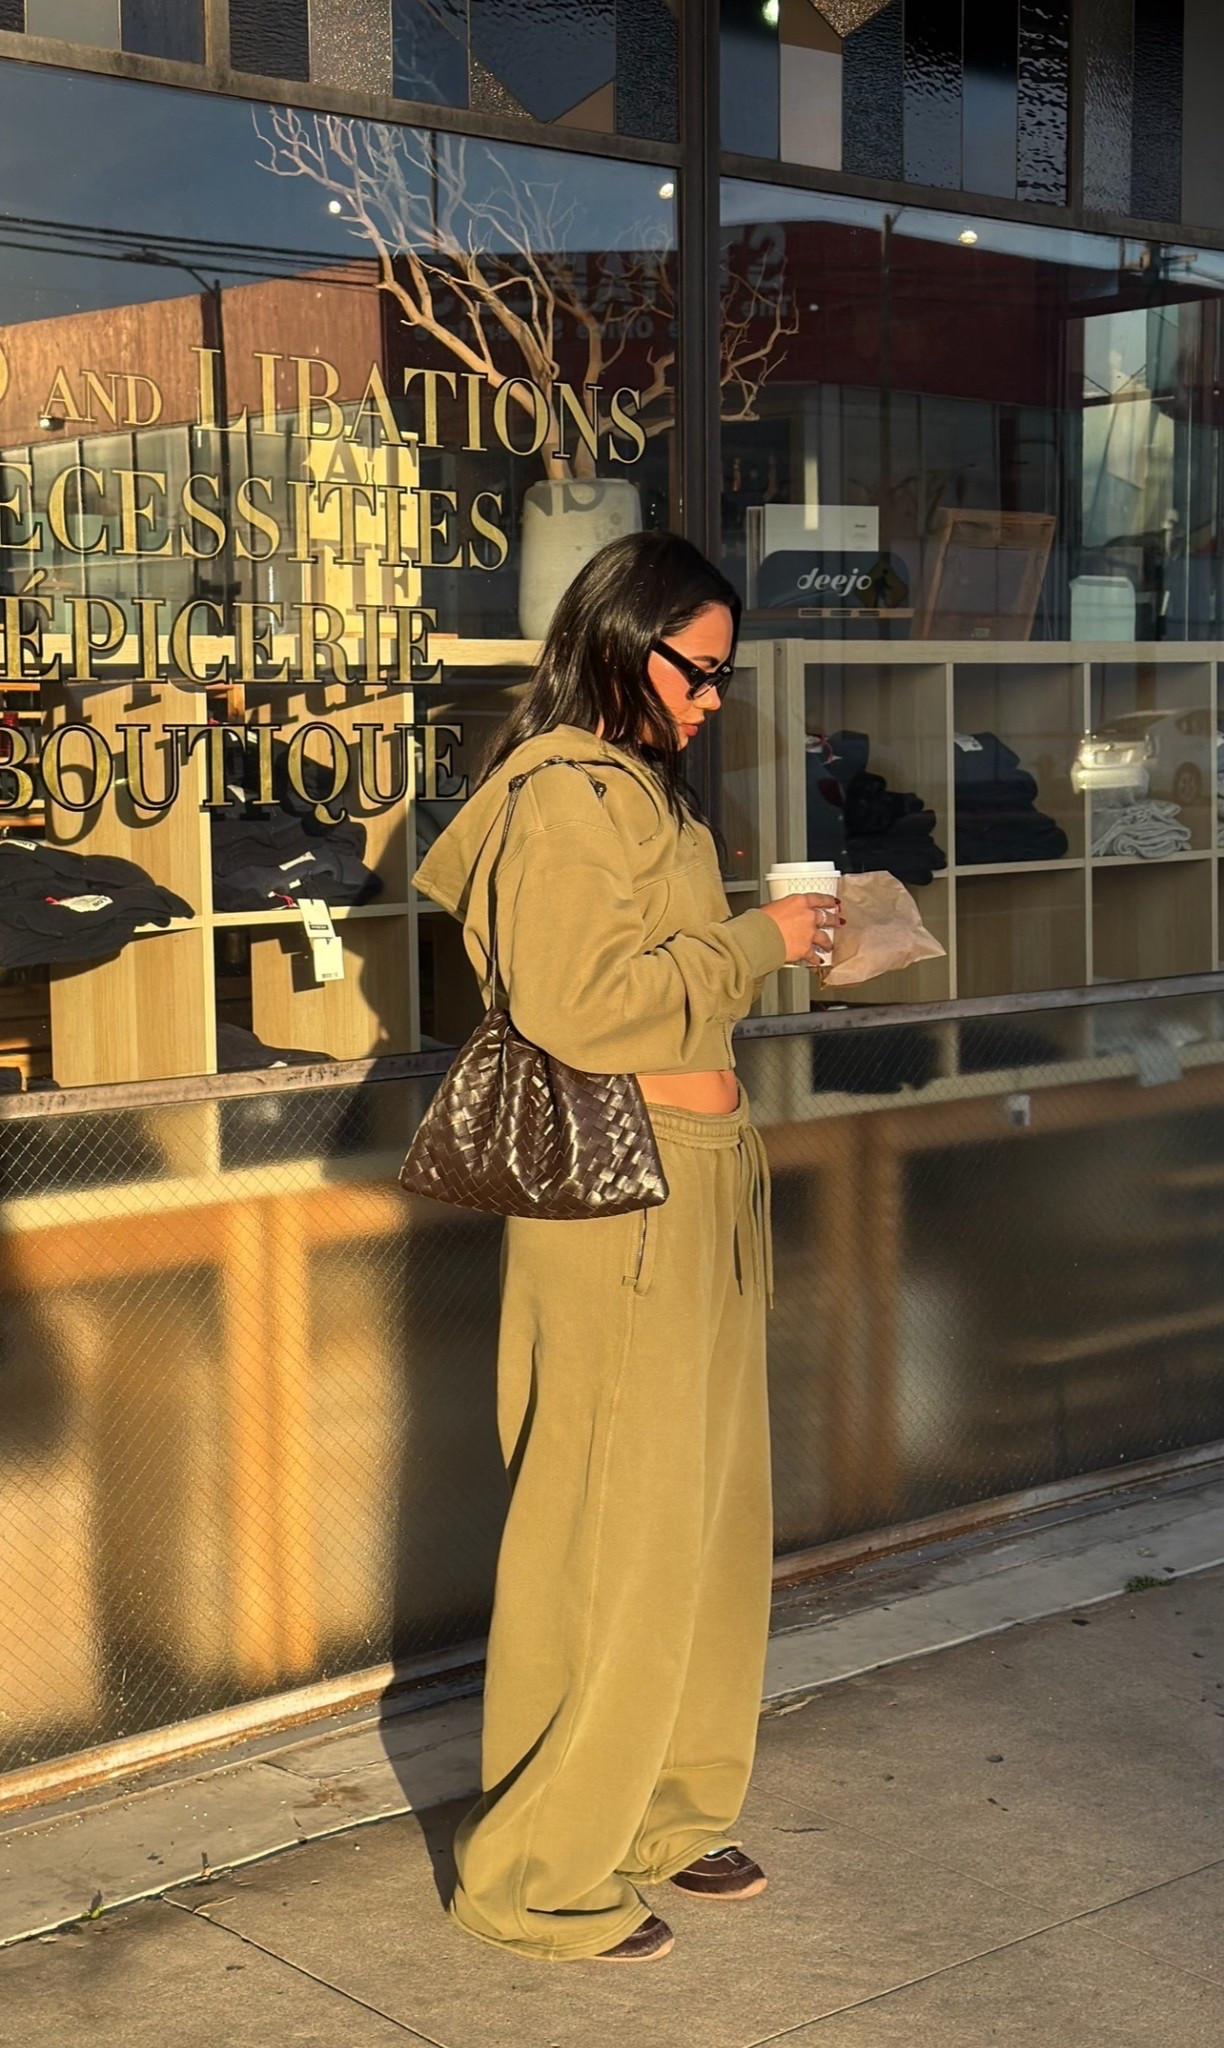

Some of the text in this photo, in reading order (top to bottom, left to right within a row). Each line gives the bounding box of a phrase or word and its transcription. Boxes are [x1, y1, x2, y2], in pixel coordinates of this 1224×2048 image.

[38, 365, 164, 426] AND
[189, 345, 648, 464] LIBATIONS
[0, 461, 510, 571] ECESSITIES
[0, 567, 444, 686] ÉPICERIE
[796, 567, 873, 598] deejo
[0, 720, 471, 826] BOUTIQUE
